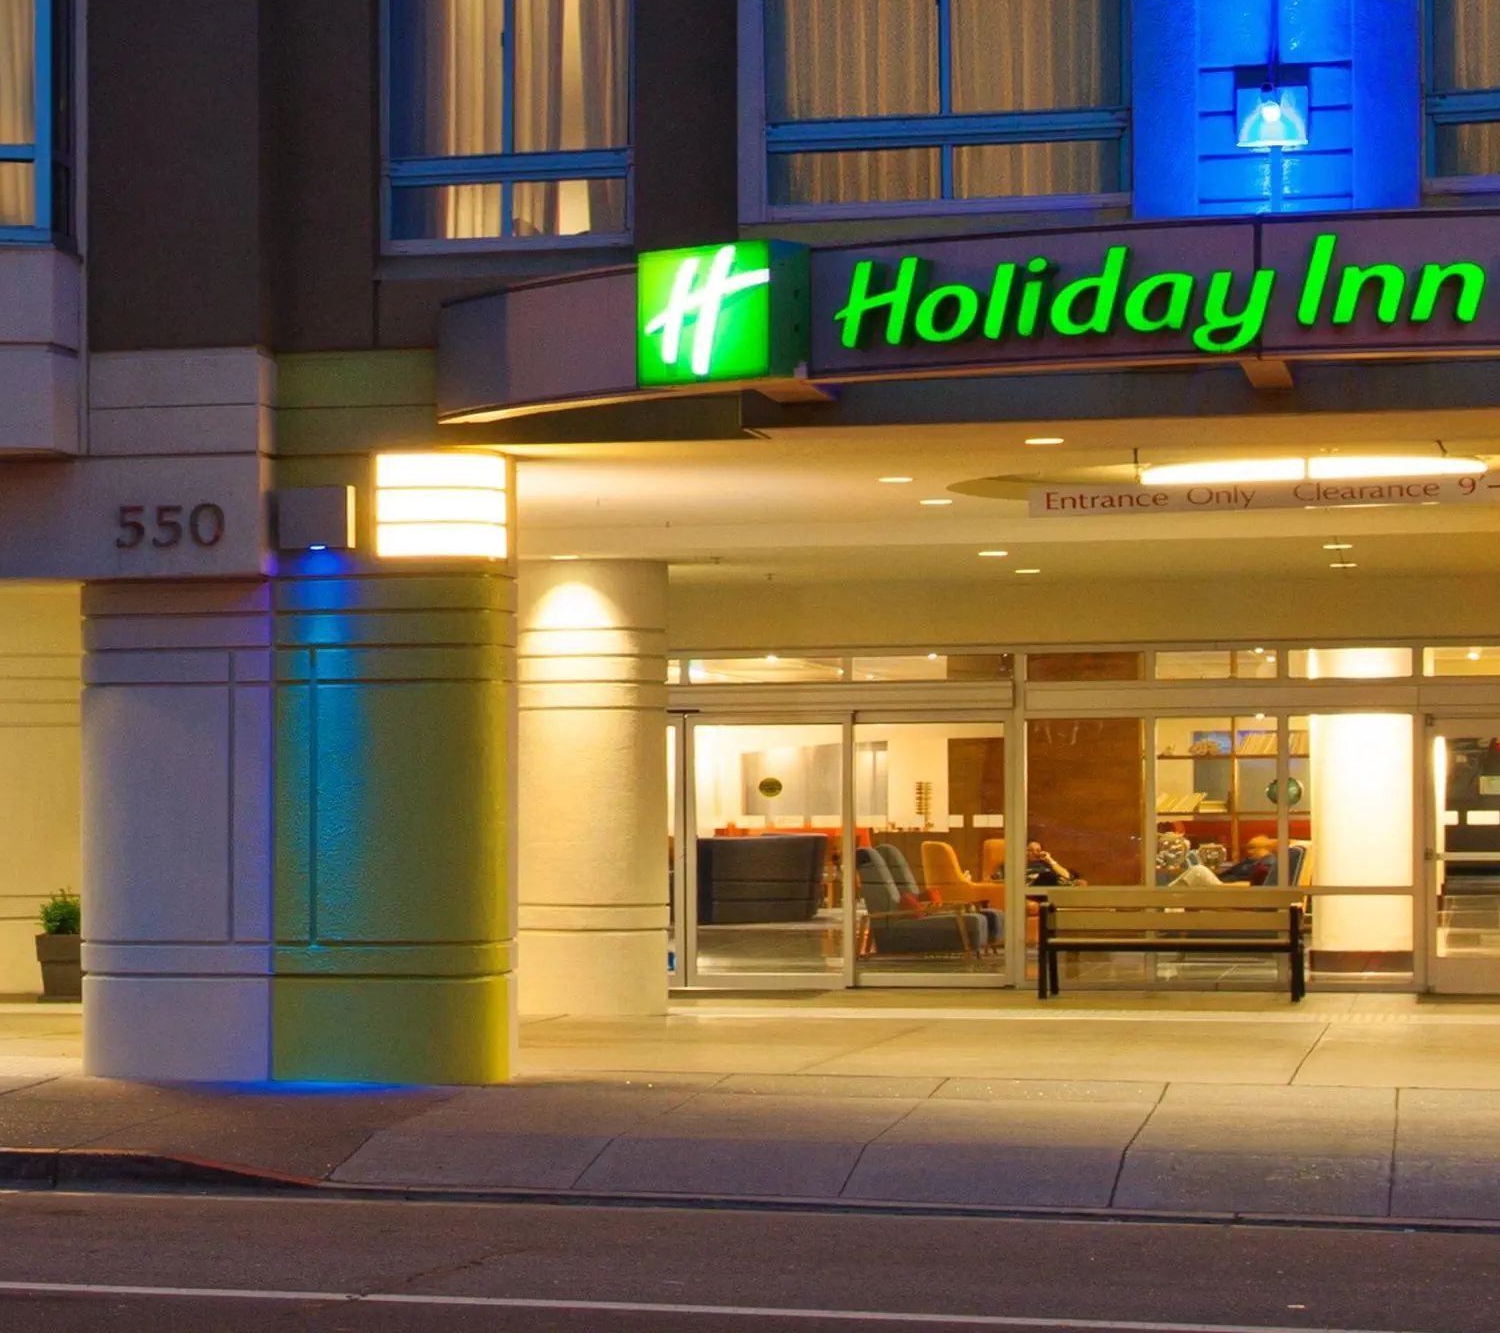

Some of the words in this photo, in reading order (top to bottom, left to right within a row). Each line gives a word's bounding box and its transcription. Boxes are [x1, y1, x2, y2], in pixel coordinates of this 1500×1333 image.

[833, 244, 1276, 353] Holiday
[1298, 233, 1486, 326] Inn
[1045, 490, 1169, 511] Entrance
[1186, 484, 1257, 510] Only
[1293, 480, 1441, 503] Clearance
[115, 502, 226, 550] 550
